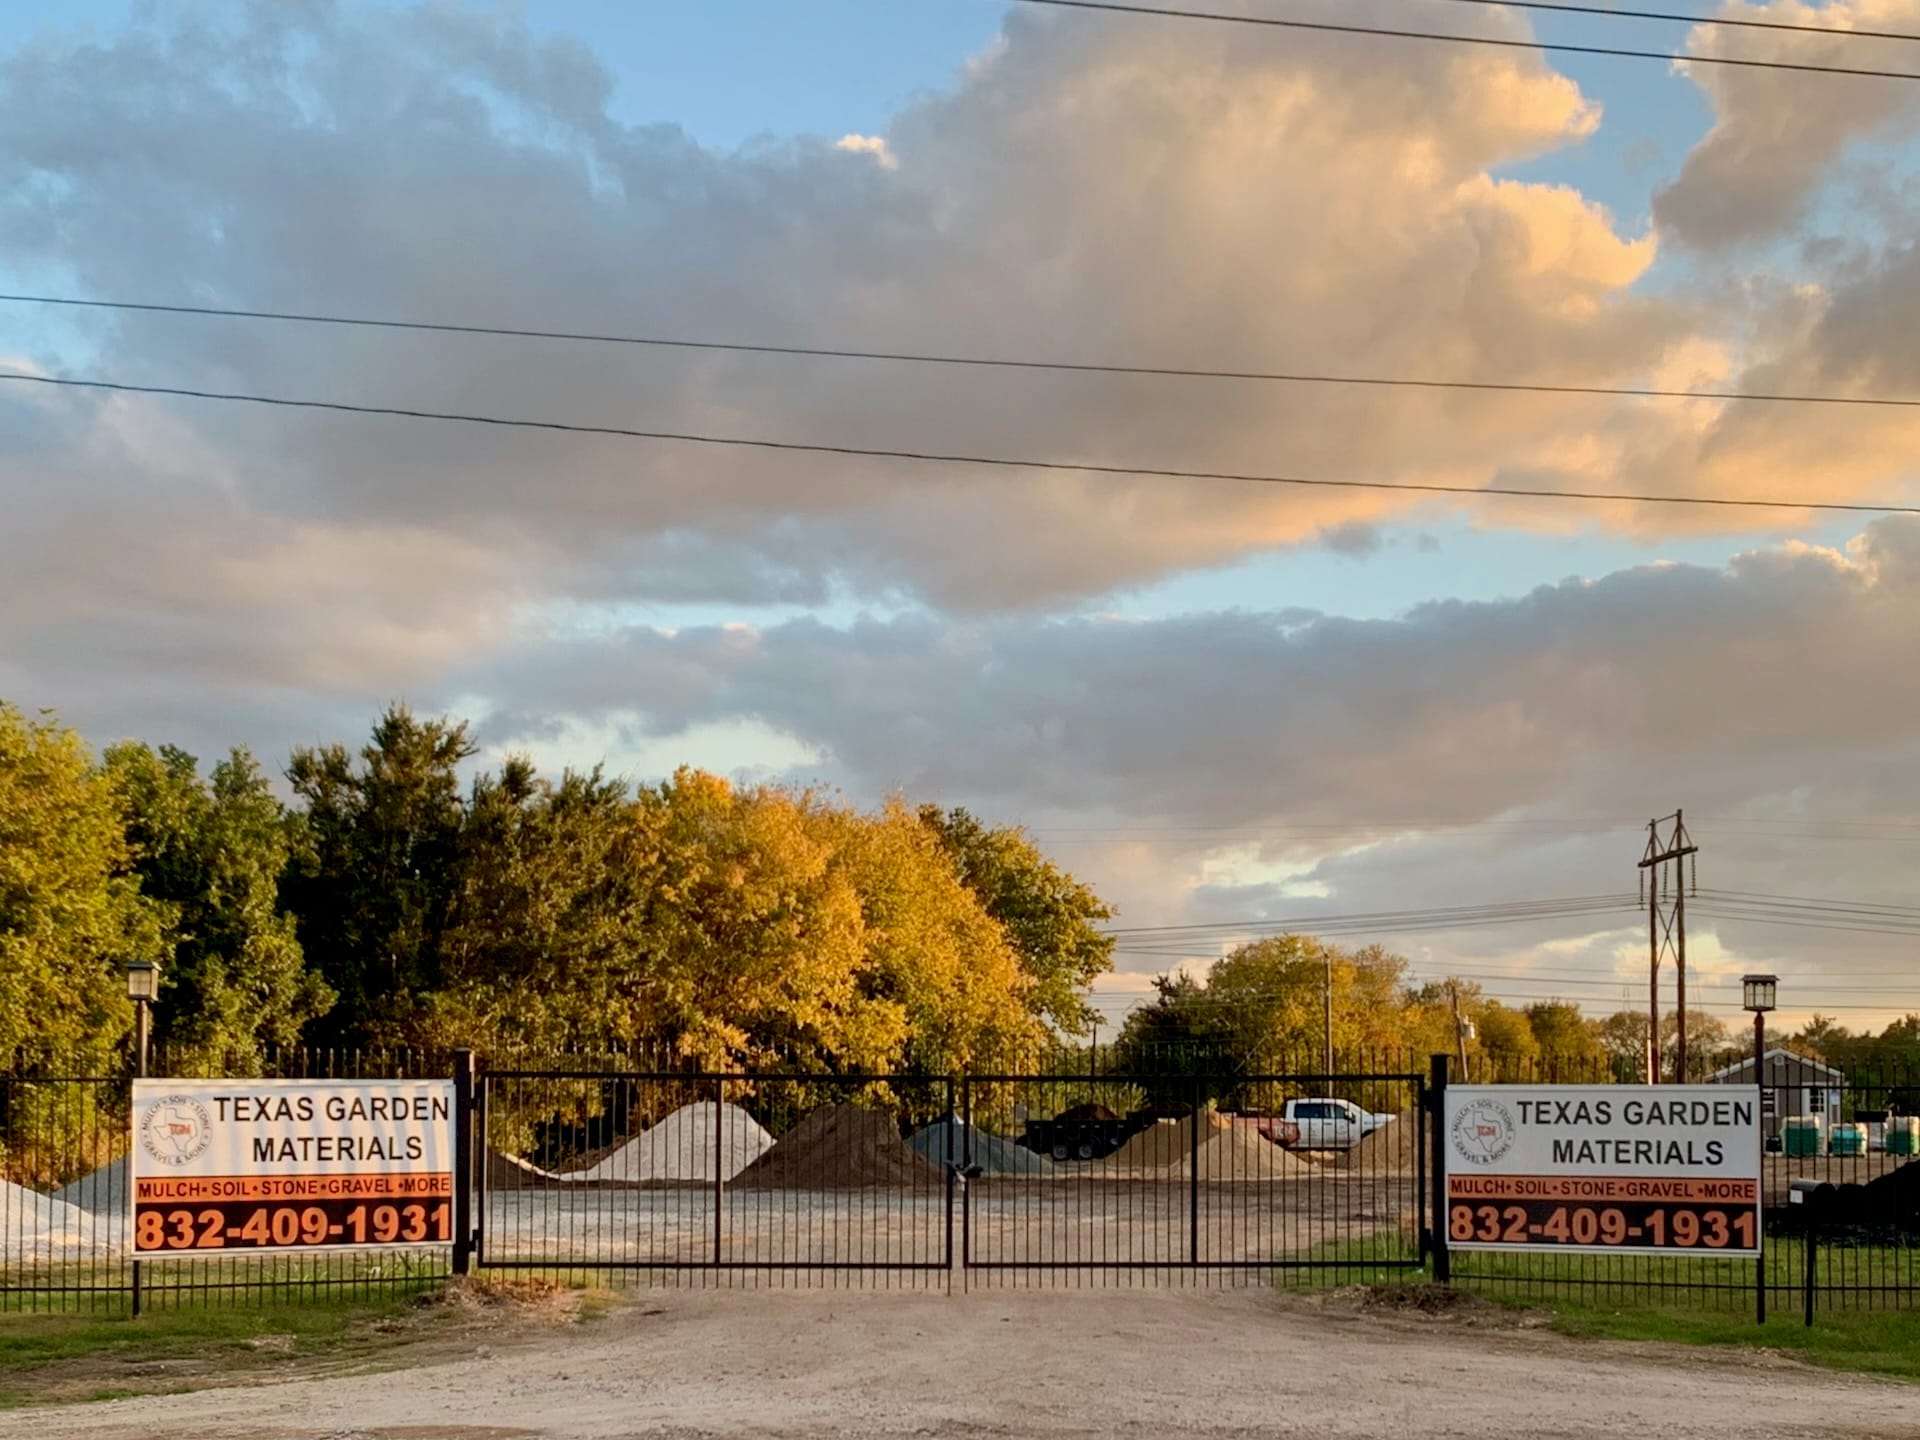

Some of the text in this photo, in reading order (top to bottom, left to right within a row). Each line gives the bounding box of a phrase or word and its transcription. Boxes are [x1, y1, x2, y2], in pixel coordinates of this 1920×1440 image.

[214, 1097, 448, 1121] TEXAS GARDEN
[1517, 1101, 1752, 1126] TEXAS GARDEN
[253, 1136, 422, 1162] MATERIALS
[1553, 1140, 1723, 1165] MATERIALS
[137, 1204, 449, 1250] 832-409-1931
[1450, 1205, 1754, 1248] 832-409-1931
